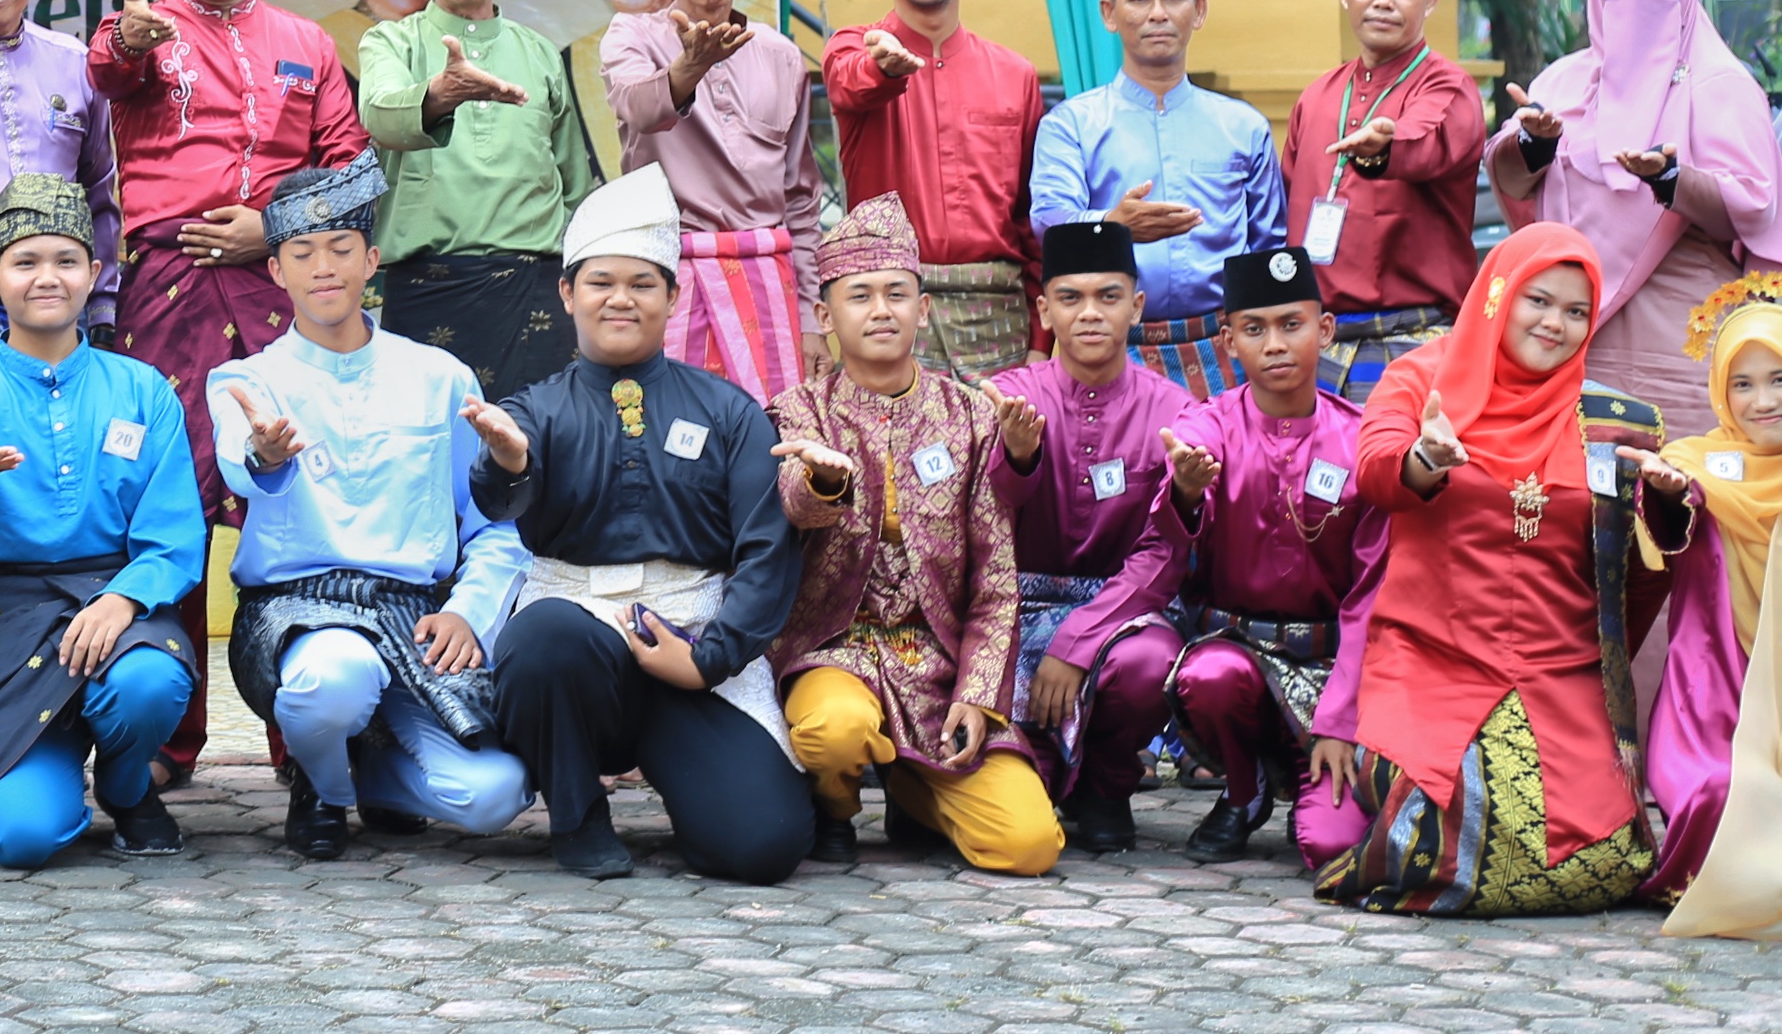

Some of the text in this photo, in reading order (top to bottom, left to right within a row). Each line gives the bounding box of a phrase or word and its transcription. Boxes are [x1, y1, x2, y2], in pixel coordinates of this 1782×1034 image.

[115, 432, 132, 447] 20
[680, 433, 694, 447] 14
[314, 455, 323, 468] 4
[926, 456, 943, 472] 12
[1720, 462, 1728, 473] 5
[1106, 471, 1114, 486] 8
[1319, 473, 1334, 488] 16
